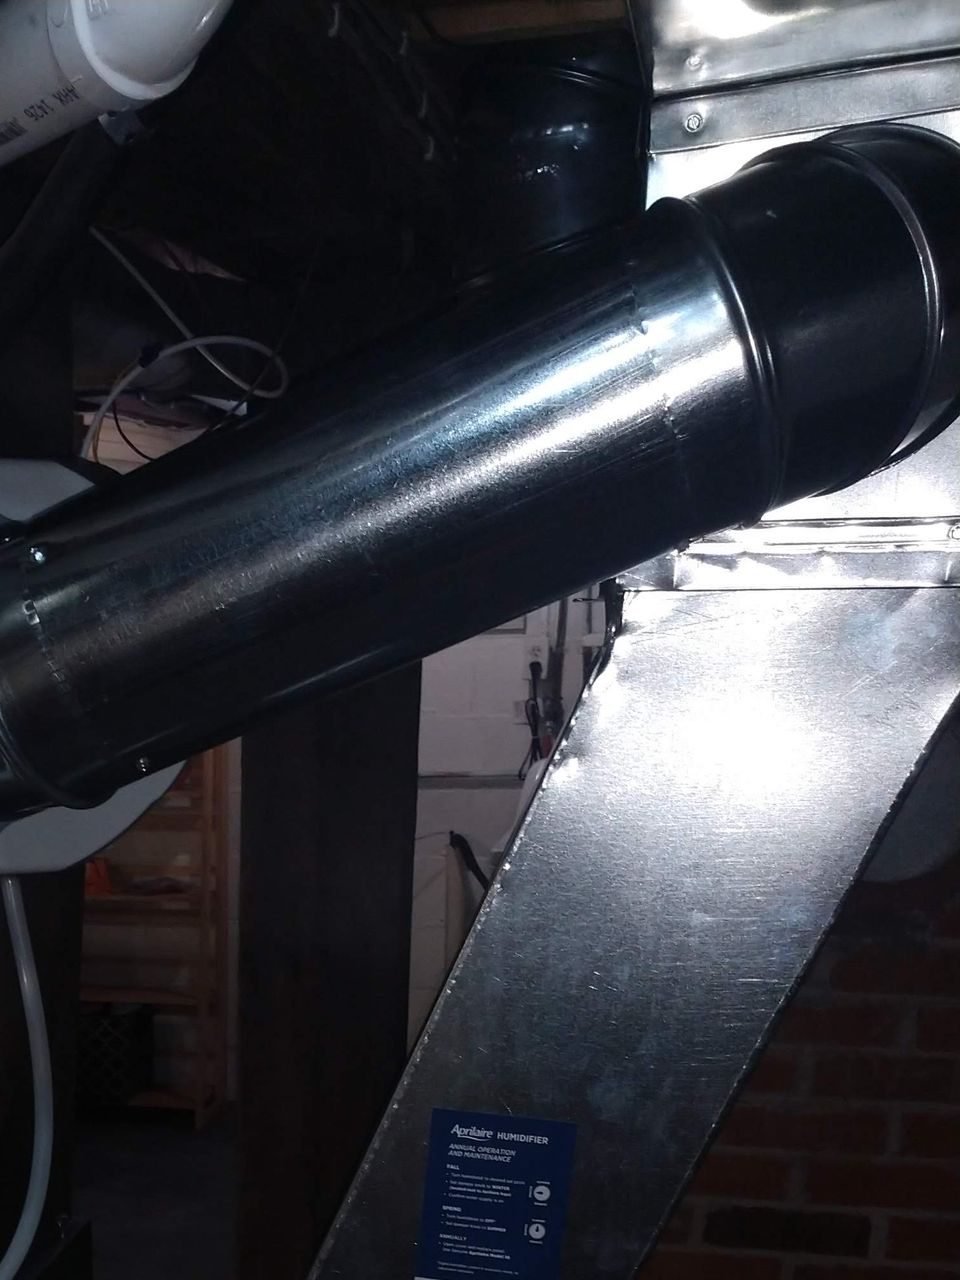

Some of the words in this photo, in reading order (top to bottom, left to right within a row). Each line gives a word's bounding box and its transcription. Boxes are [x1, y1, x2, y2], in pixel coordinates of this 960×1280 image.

[450, 1124, 493, 1141] Aprilaire
[497, 1131, 549, 1145] HUMIDIFIER
[448, 1149, 463, 1158] AND
[464, 1151, 512, 1163] MAINTENANCE
[449, 1143, 476, 1153] ANNUAL
[477, 1146, 517, 1157] OPERATION
